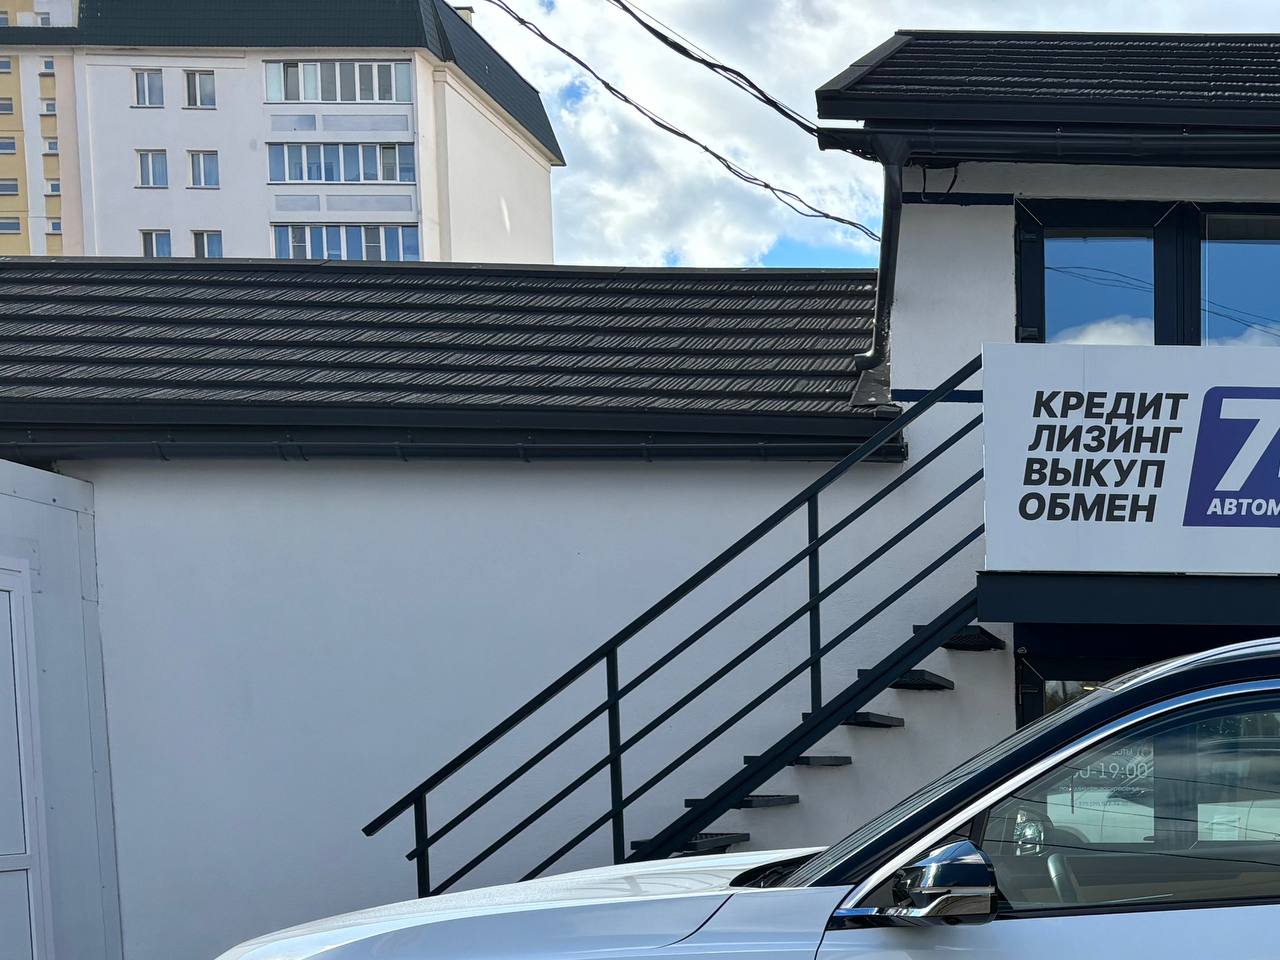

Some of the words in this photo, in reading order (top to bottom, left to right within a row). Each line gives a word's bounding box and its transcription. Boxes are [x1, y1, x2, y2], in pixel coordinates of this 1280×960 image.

[1032, 390, 1190, 425] КРЕДИТ
[1027, 424, 1184, 454] ЛИЗИНГ
[1022, 457, 1166, 489] ВЫКУП
[1018, 491, 1158, 523] ОБМЕН
